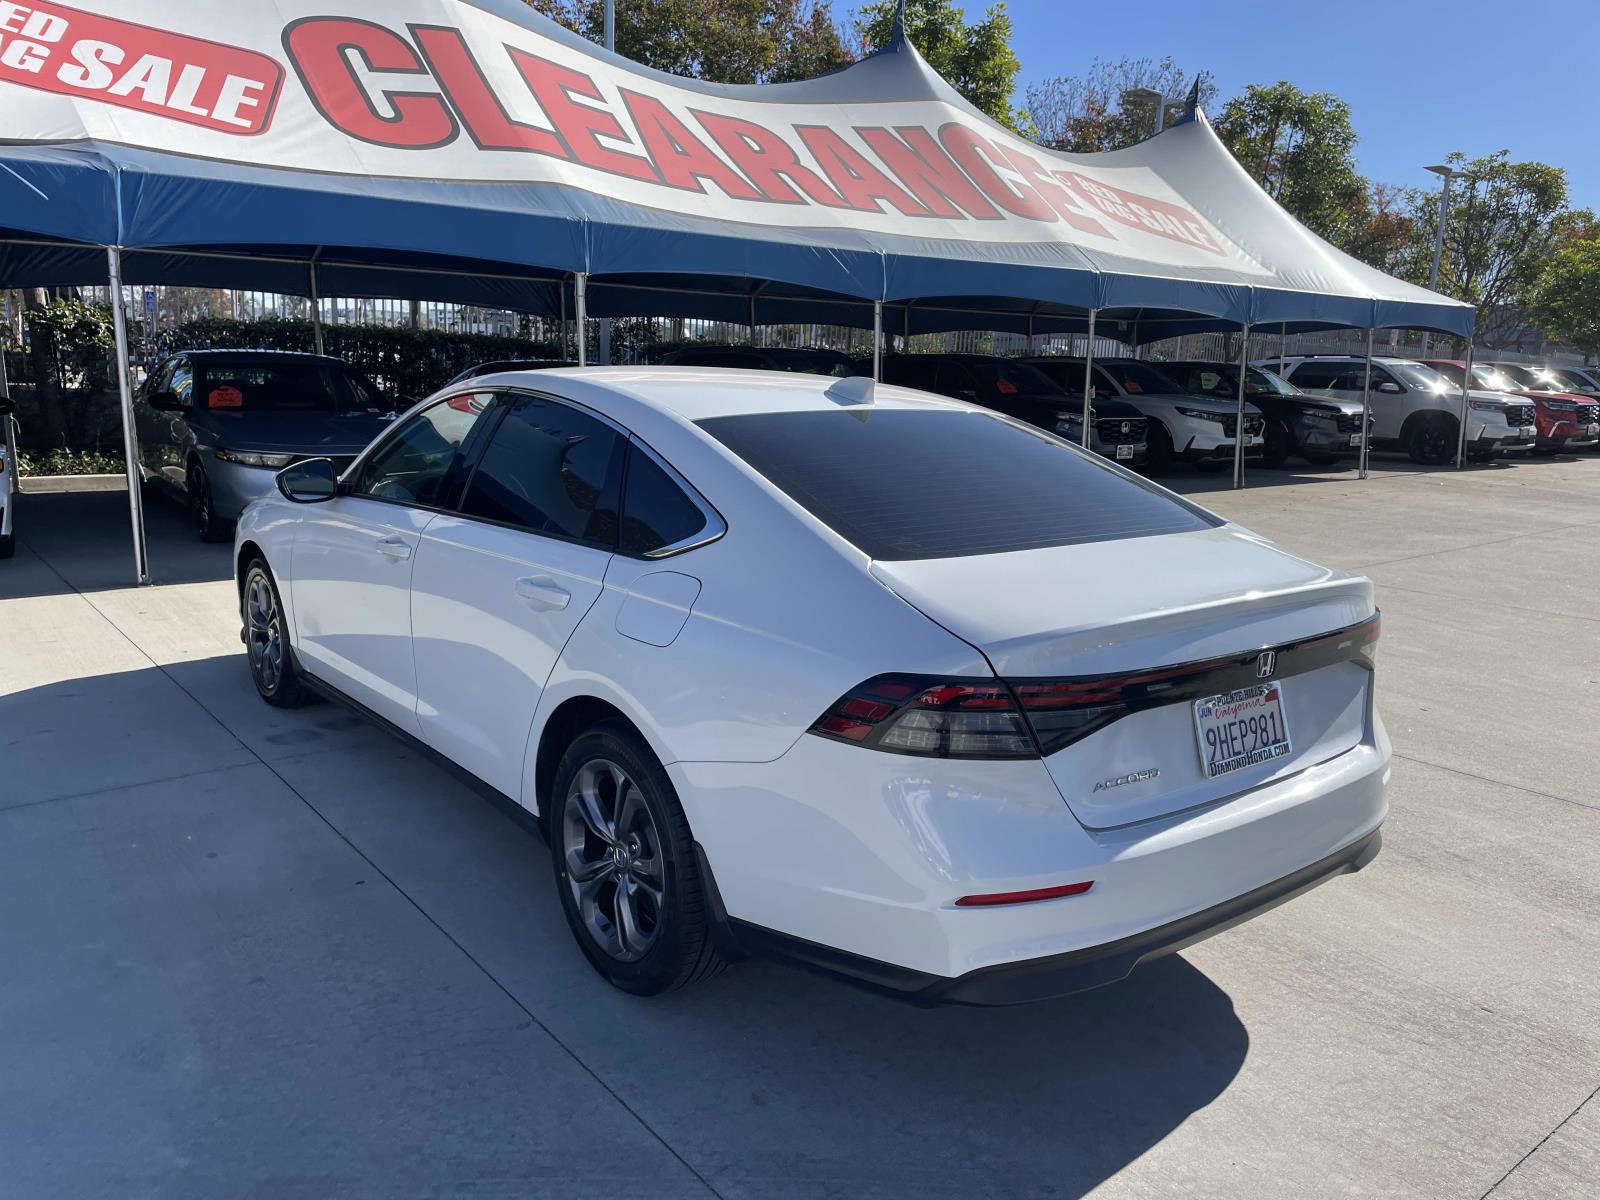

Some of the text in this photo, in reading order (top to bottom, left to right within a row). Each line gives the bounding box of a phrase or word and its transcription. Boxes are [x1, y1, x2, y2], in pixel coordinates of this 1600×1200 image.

[56, 39, 265, 129] SALE
[282, 15, 1118, 241] CLEARANCE
[1073, 174, 1123, 205] RED
[1088, 192, 1140, 223] TAG
[1127, 202, 1220, 251] SALE
[1215, 698, 1266, 720] California
[1206, 711, 1281, 761] 9HEP981
[1093, 768, 1160, 793] ACCORD
